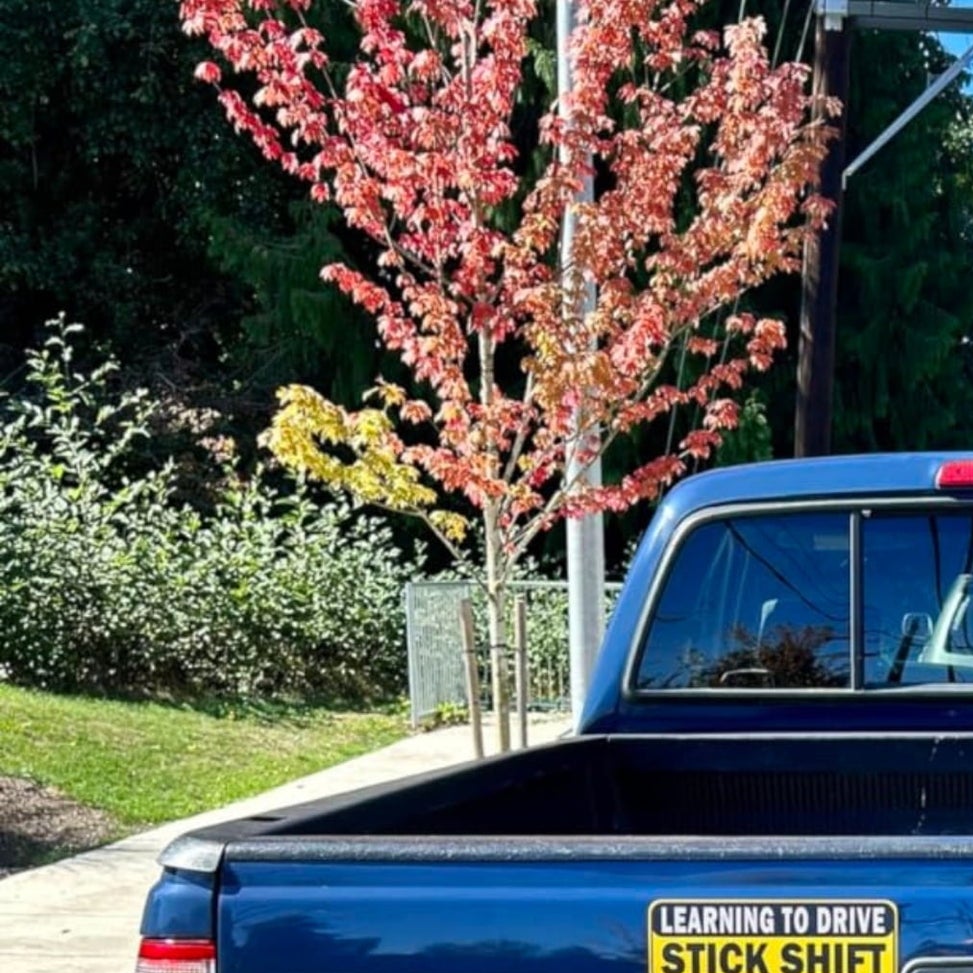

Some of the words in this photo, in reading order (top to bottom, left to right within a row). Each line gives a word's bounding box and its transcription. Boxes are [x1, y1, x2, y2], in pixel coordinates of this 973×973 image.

[660, 906, 774, 934] LEARNING
[781, 906, 810, 934] TO
[816, 906, 886, 934] DRIVE
